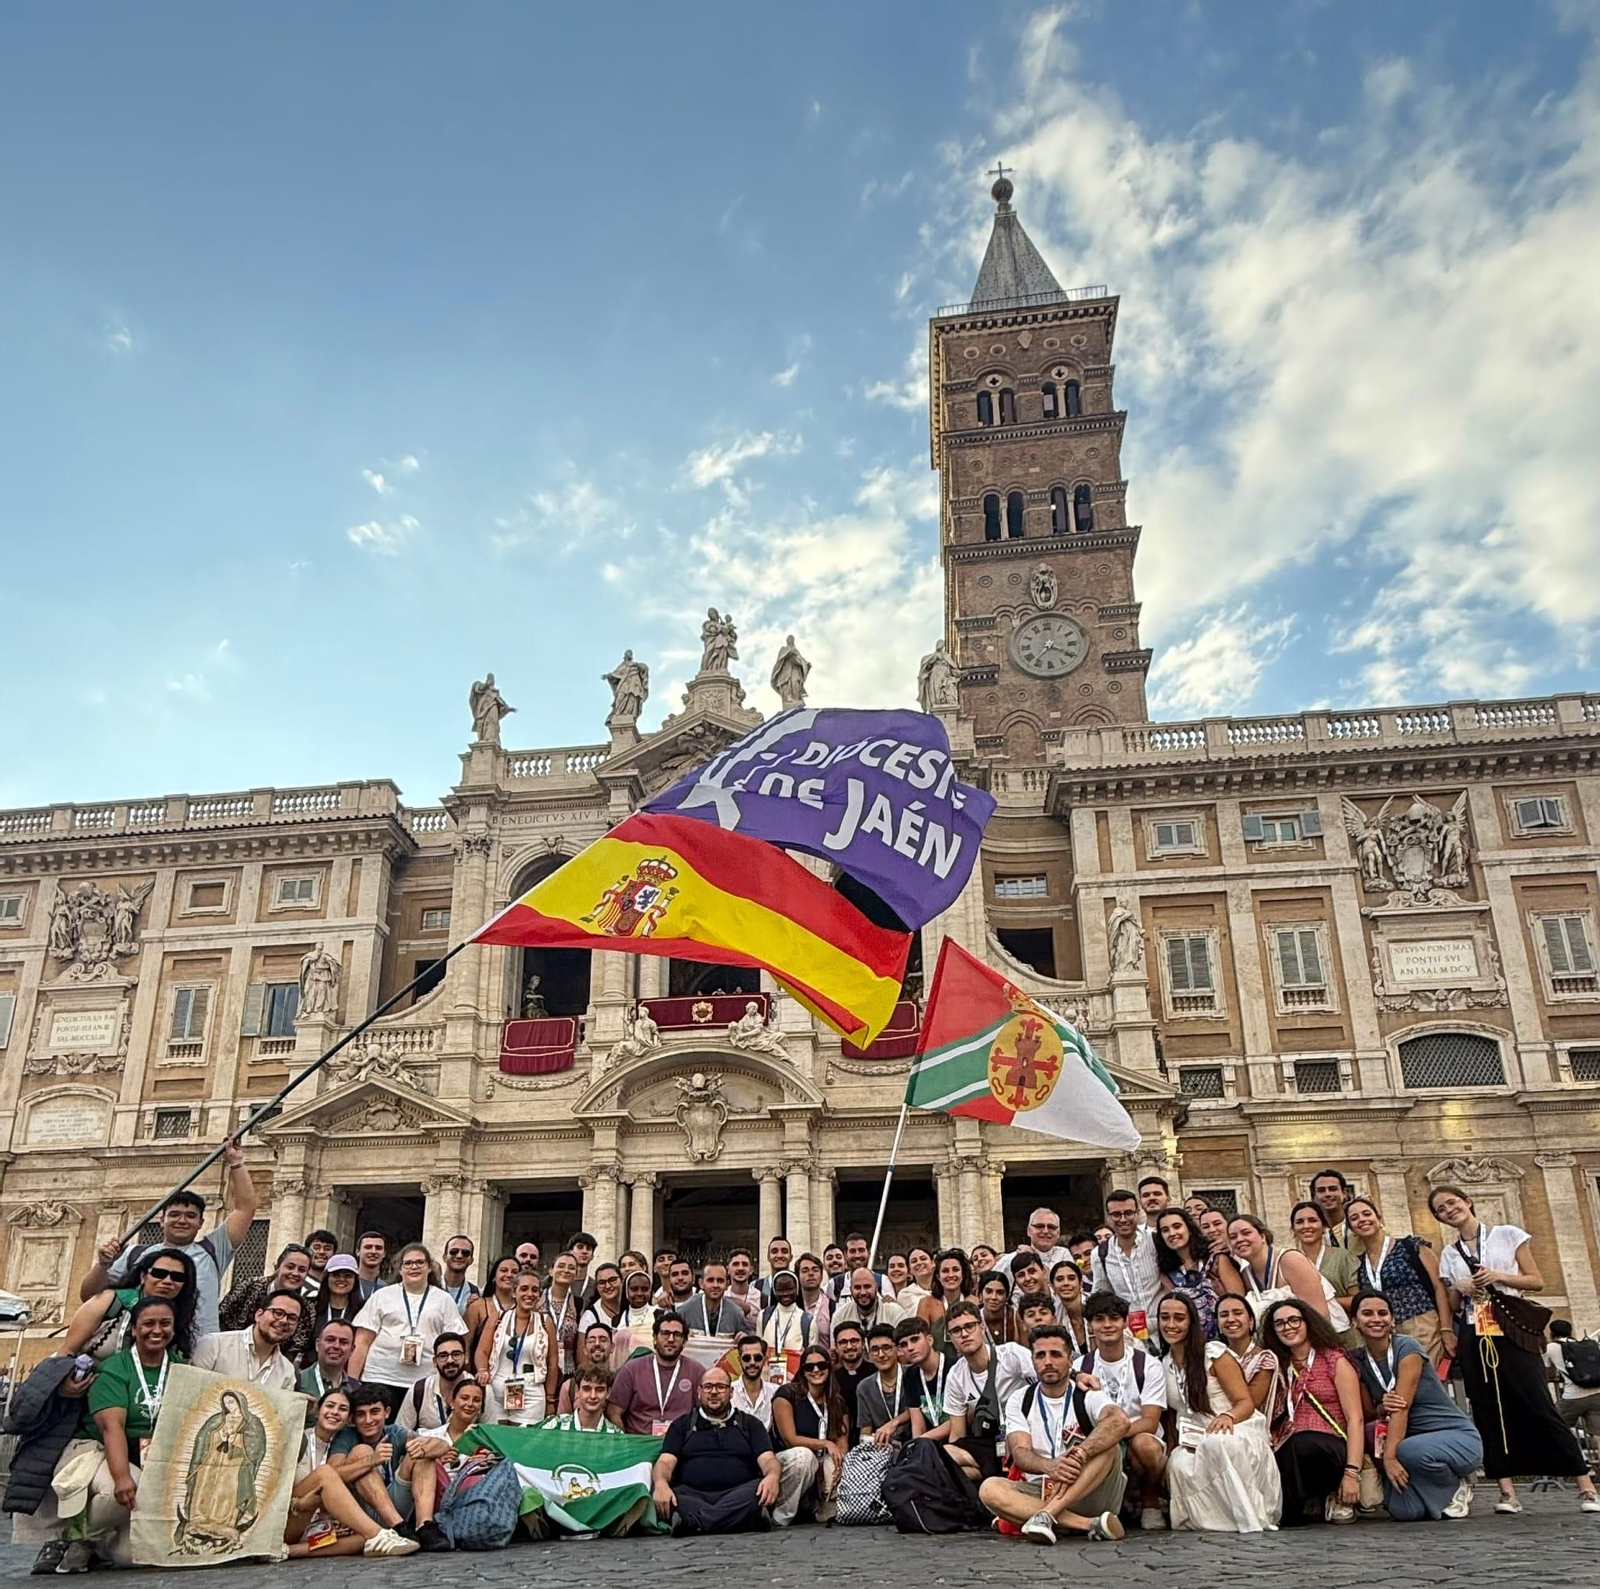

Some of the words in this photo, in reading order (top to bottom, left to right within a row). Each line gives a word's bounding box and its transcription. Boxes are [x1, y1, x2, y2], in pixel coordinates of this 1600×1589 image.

[492, 814, 566, 826] BENEDICTVS
[571, 811, 591, 821] XIV
[758, 772, 826, 810] DE
[822, 778, 962, 880] JAÉN
